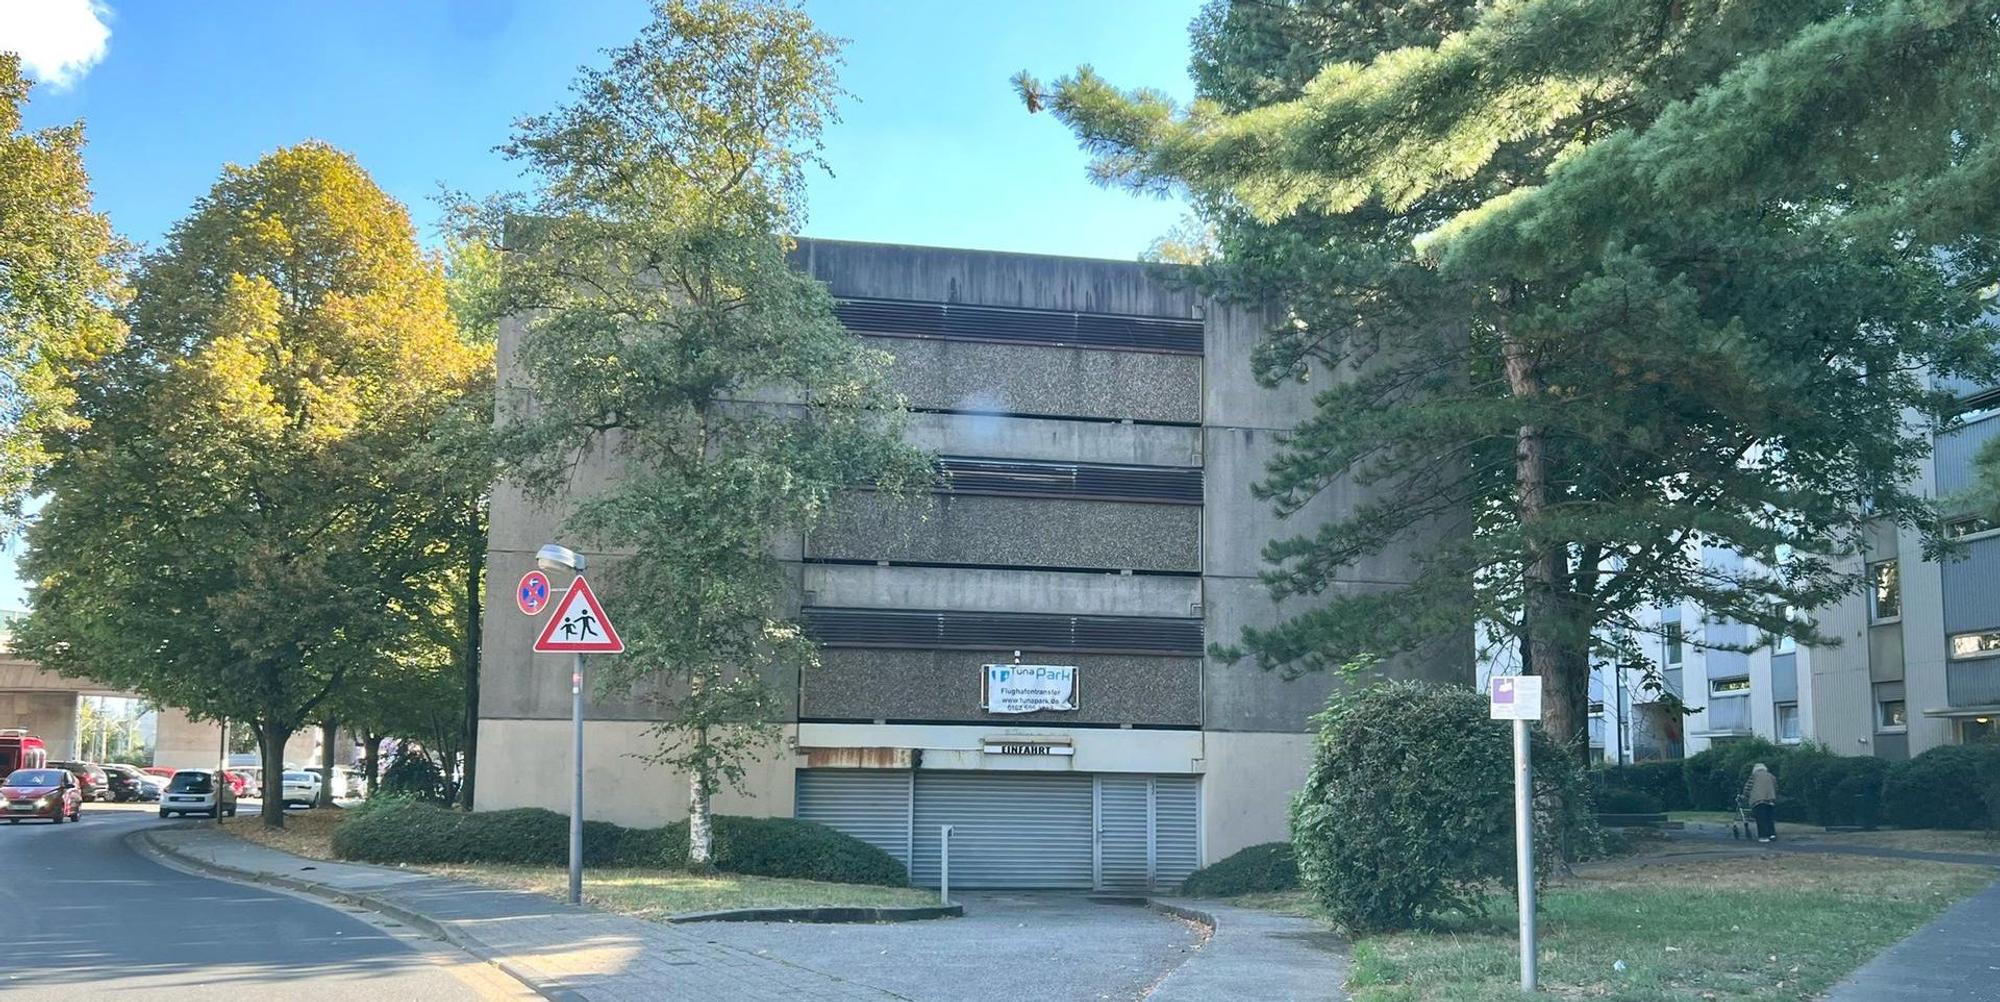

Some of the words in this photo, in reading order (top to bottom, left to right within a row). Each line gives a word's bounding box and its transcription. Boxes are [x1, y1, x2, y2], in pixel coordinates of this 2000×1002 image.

[1010, 667, 1035, 676] Tuna
[1036, 667, 1070, 681] Park
[1002, 745, 1051, 756] EINFAHRT
